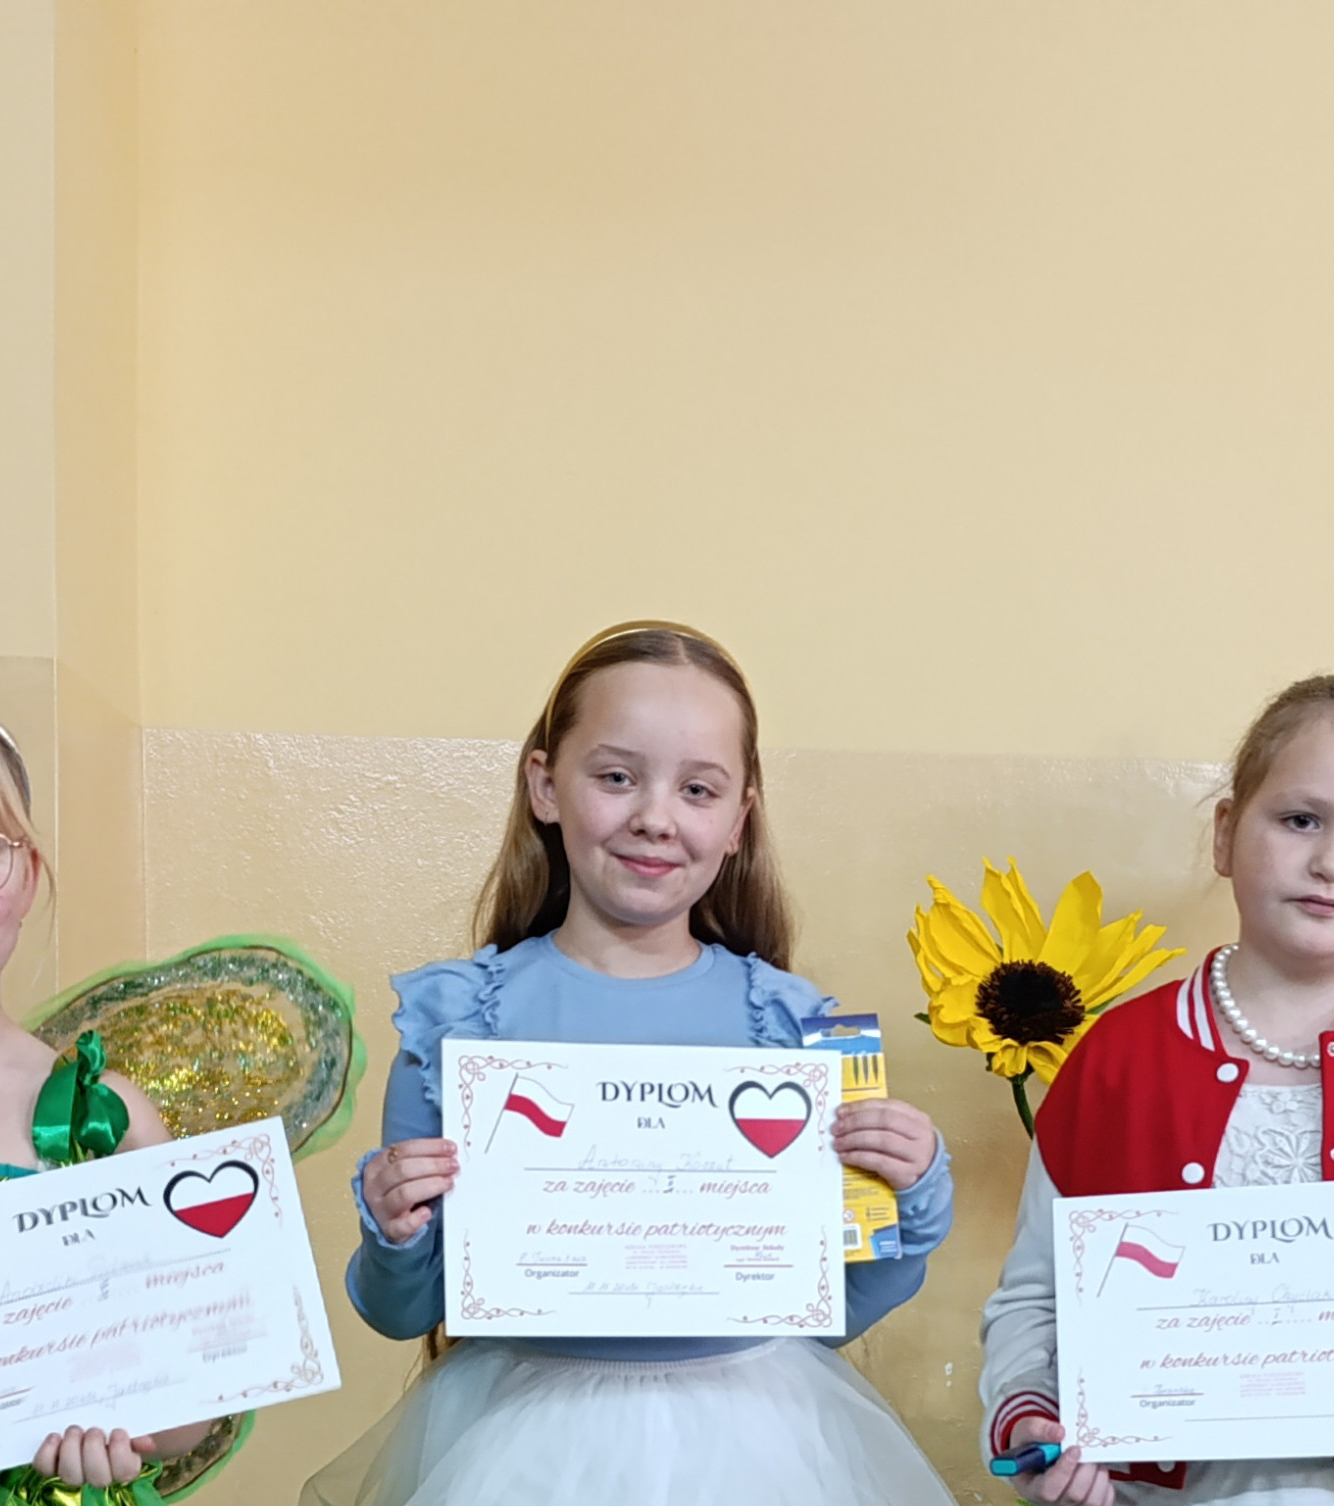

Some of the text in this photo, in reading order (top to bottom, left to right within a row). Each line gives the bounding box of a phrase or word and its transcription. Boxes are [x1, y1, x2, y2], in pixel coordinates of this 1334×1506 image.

[596, 1081, 718, 1109] DYPLOM
[637, 1117, 665, 1130] DLA
[543, 1180, 567, 1193] za
[573, 1178, 635, 1199] zajęcie
[699, 1179, 770, 1200] miejsca
[11, 1187, 152, 1234] DYPLOM
[62, 1229, 97, 1247] DLA
[526, 1218, 786, 1243] w konkursie patriotycznym
[1207, 1216, 1334, 1243] DYPLOM
[1250, 1253, 1279, 1265] DLA
[525, 1268, 579, 1281] Organizator
[735, 1271, 775, 1283] Dyrektor
[3, 1297, 73, 1325] zajęcie
[145, 1262, 225, 1288] miejsca
[1156, 1316, 1182, 1330] za
[1186, 1311, 1250, 1333] zajęcie
[1140, 1356, 1156, 1370] w
[1161, 1348, 1259, 1370] konkursie
[1139, 1398, 1195, 1410] Organizator
